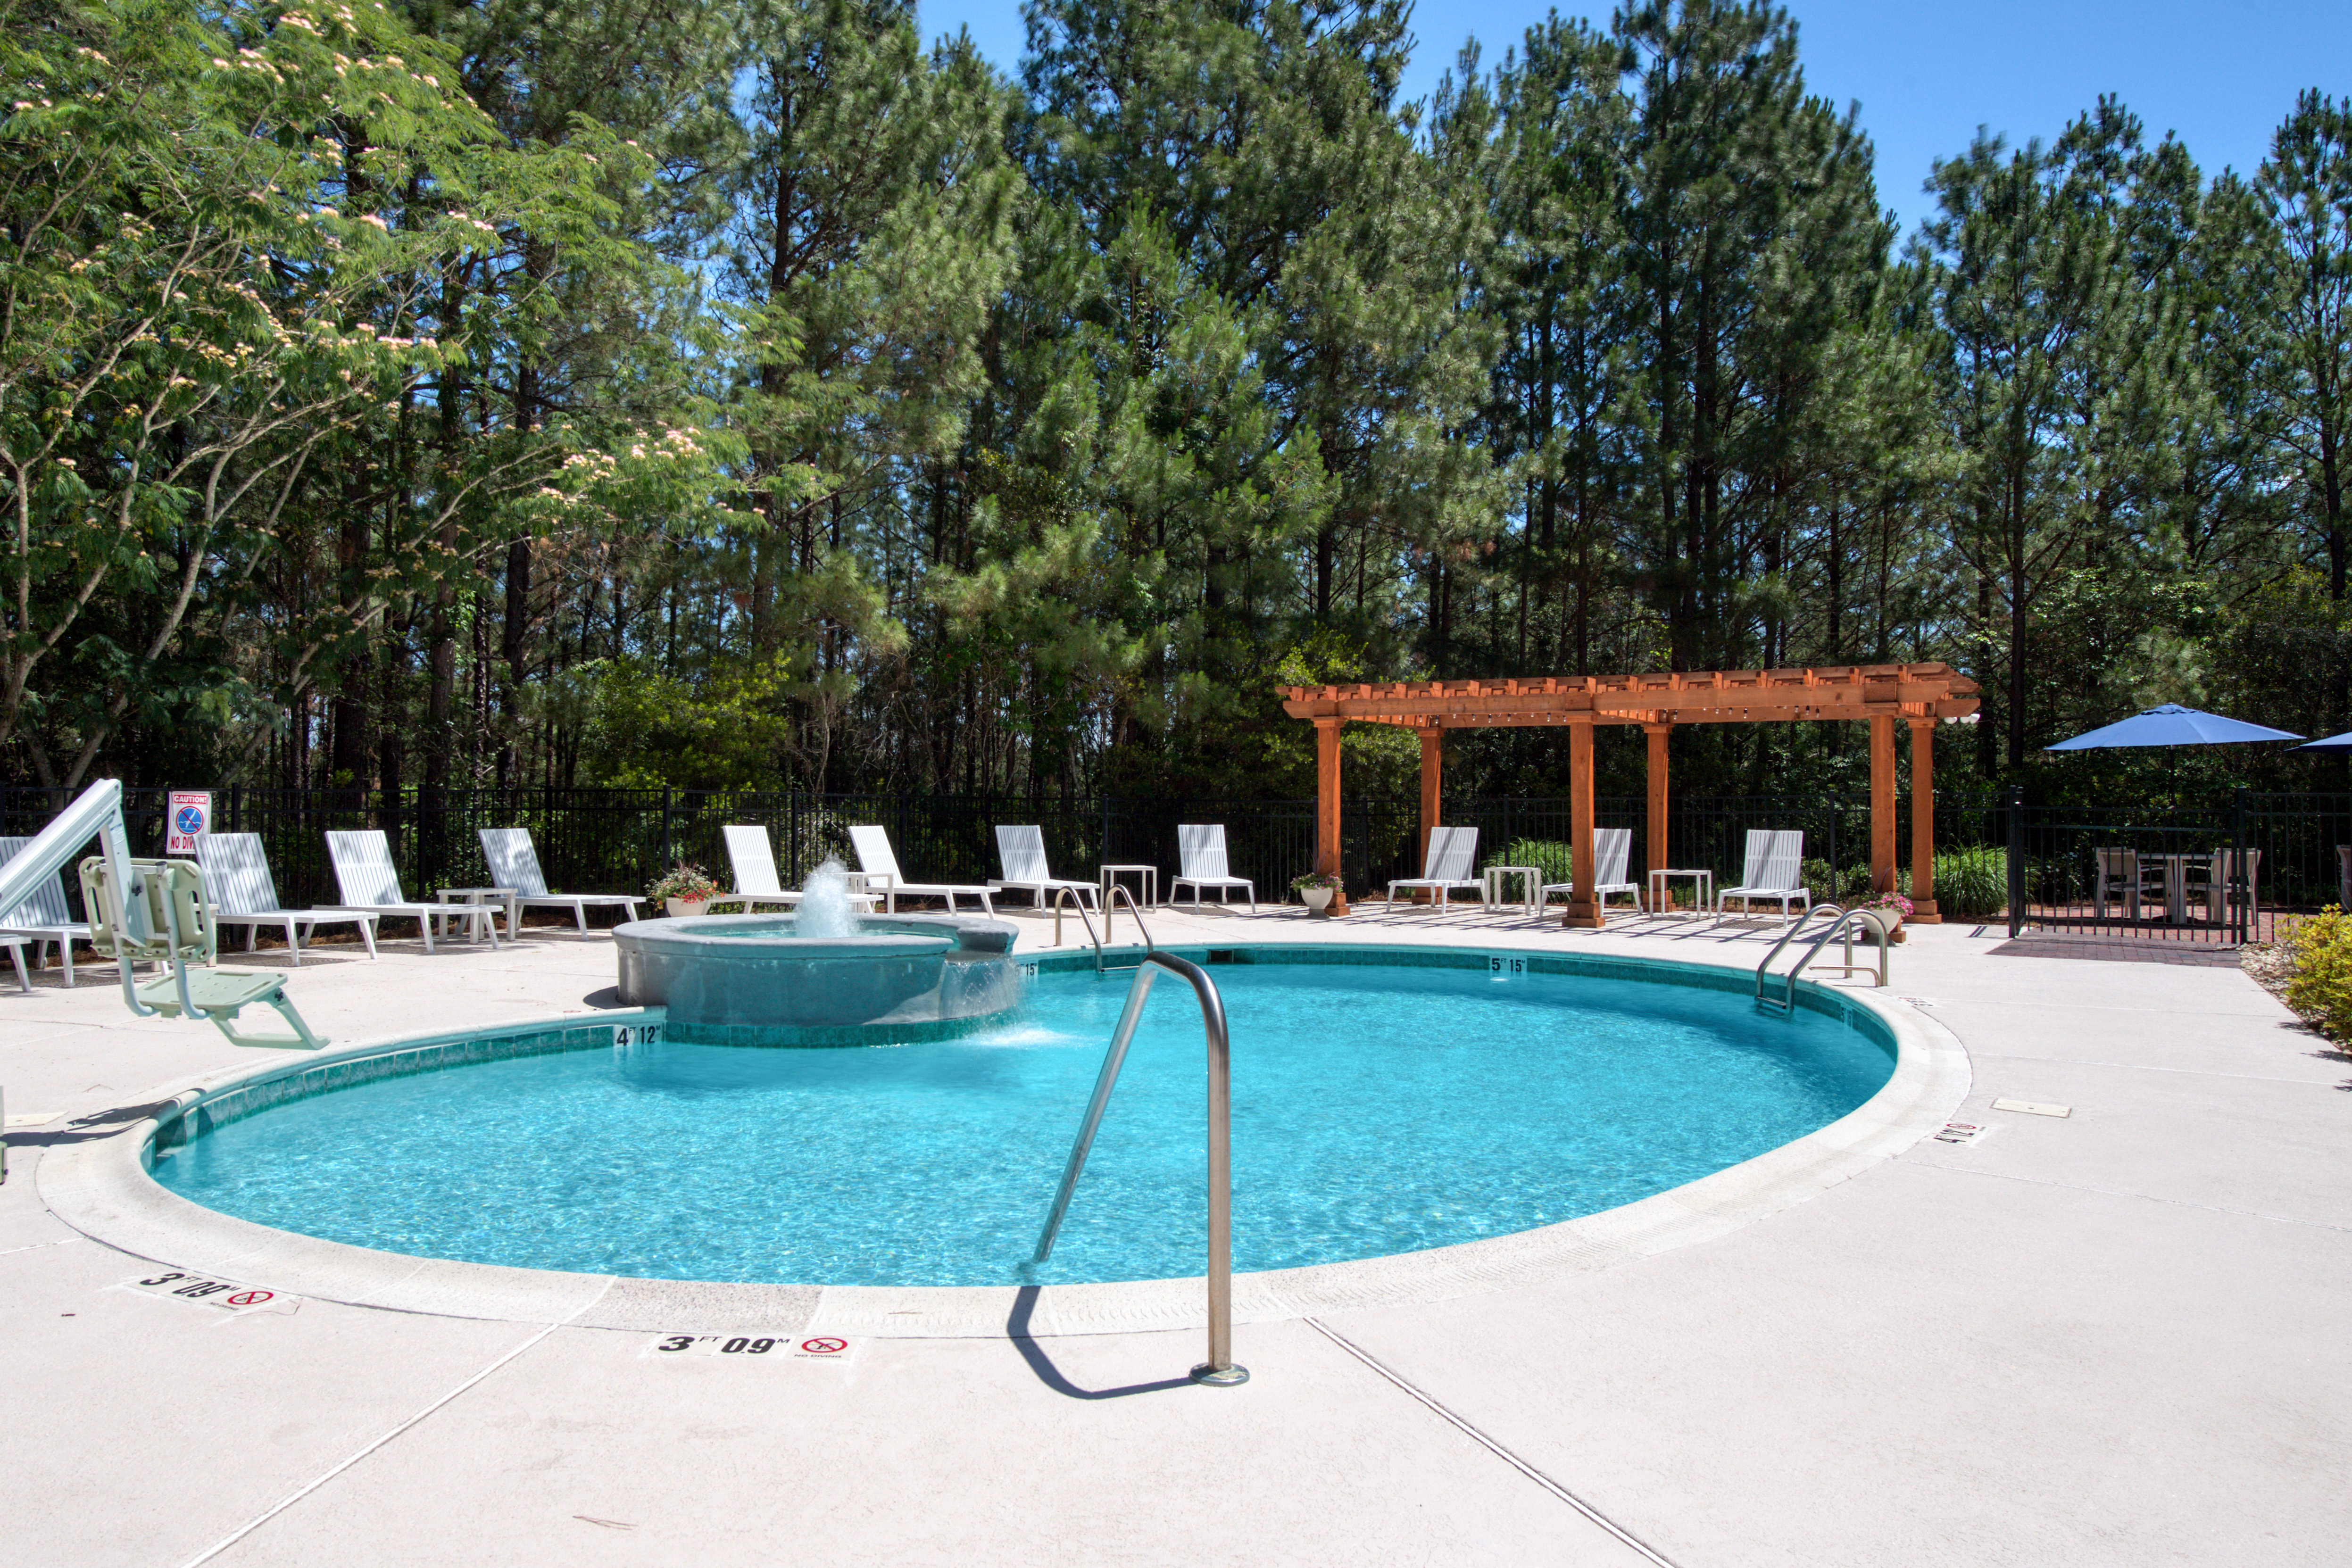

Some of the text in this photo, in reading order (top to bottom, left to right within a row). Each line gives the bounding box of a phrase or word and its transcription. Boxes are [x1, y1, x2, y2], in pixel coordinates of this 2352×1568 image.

[170, 836, 195, 849] NO DIV
[1492, 958, 1500, 971] 5
[616, 1028, 629, 1046] 4
[139, 1273, 185, 1286] 3
[658, 1336, 696, 1352] 3
